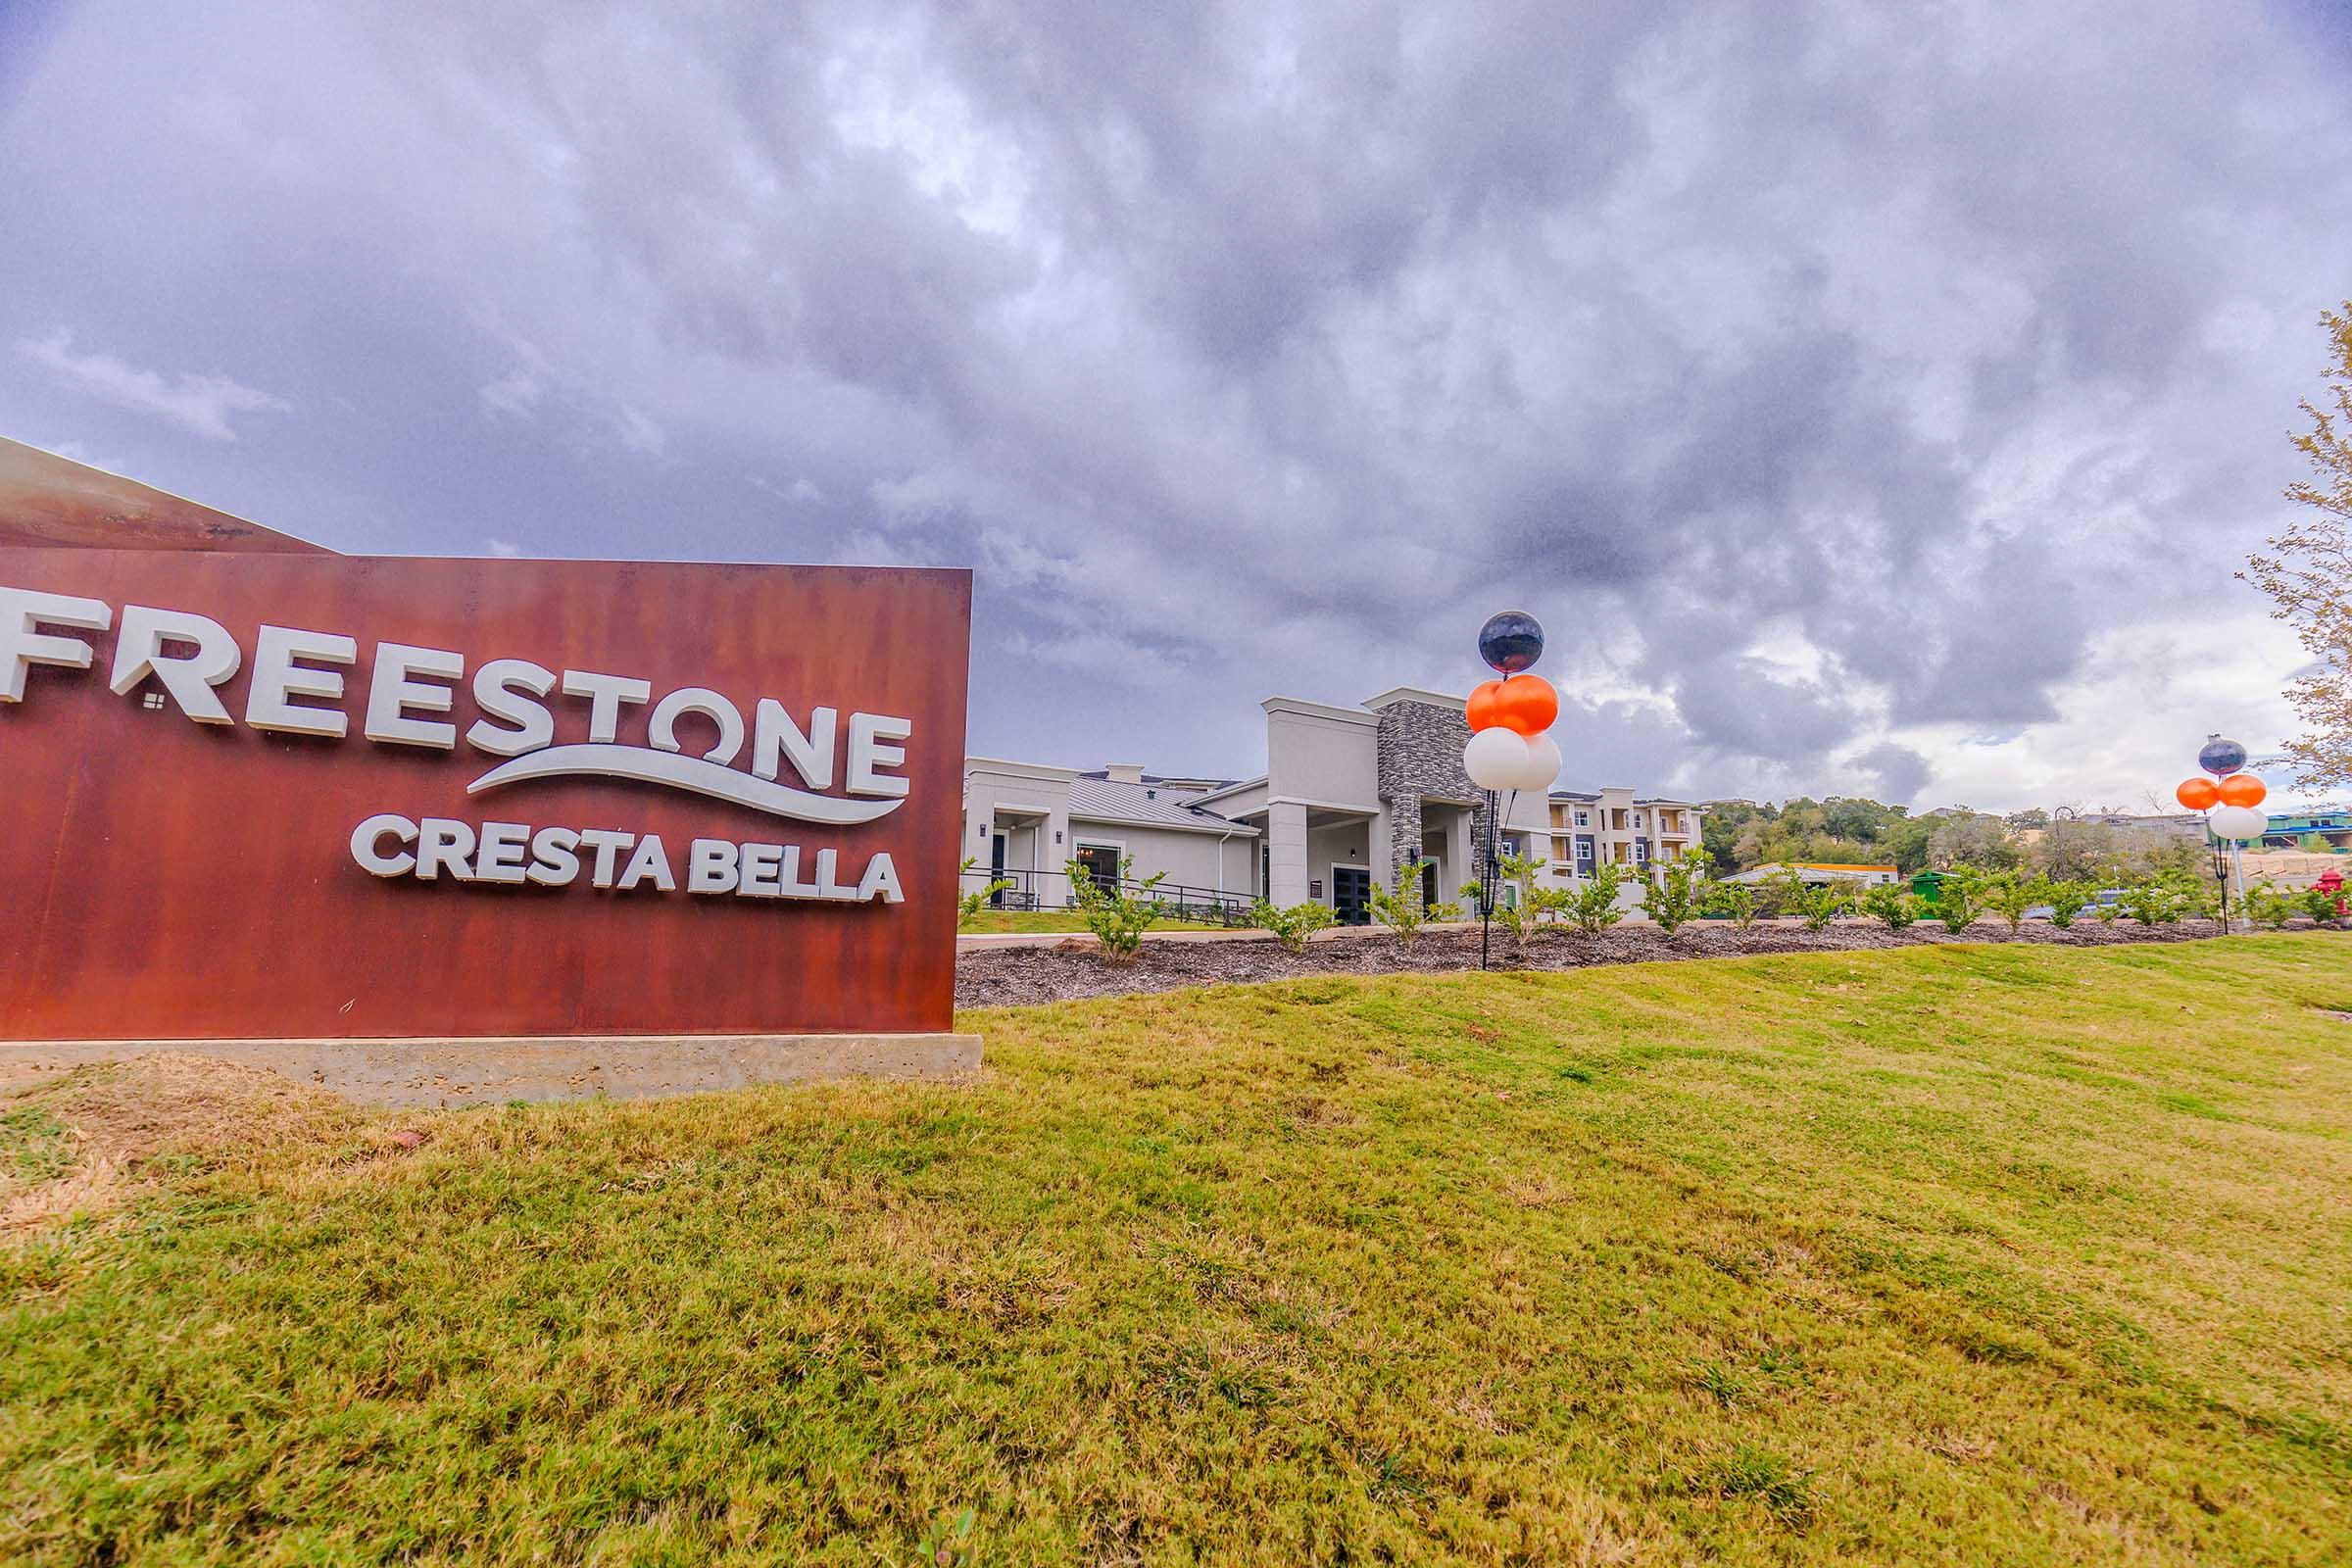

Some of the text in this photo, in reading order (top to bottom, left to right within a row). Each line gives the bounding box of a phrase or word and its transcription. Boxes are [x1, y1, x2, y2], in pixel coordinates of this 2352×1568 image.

[0, 587, 911, 796] FREESTONE
[350, 813, 905, 904] CRESTA BELLA
